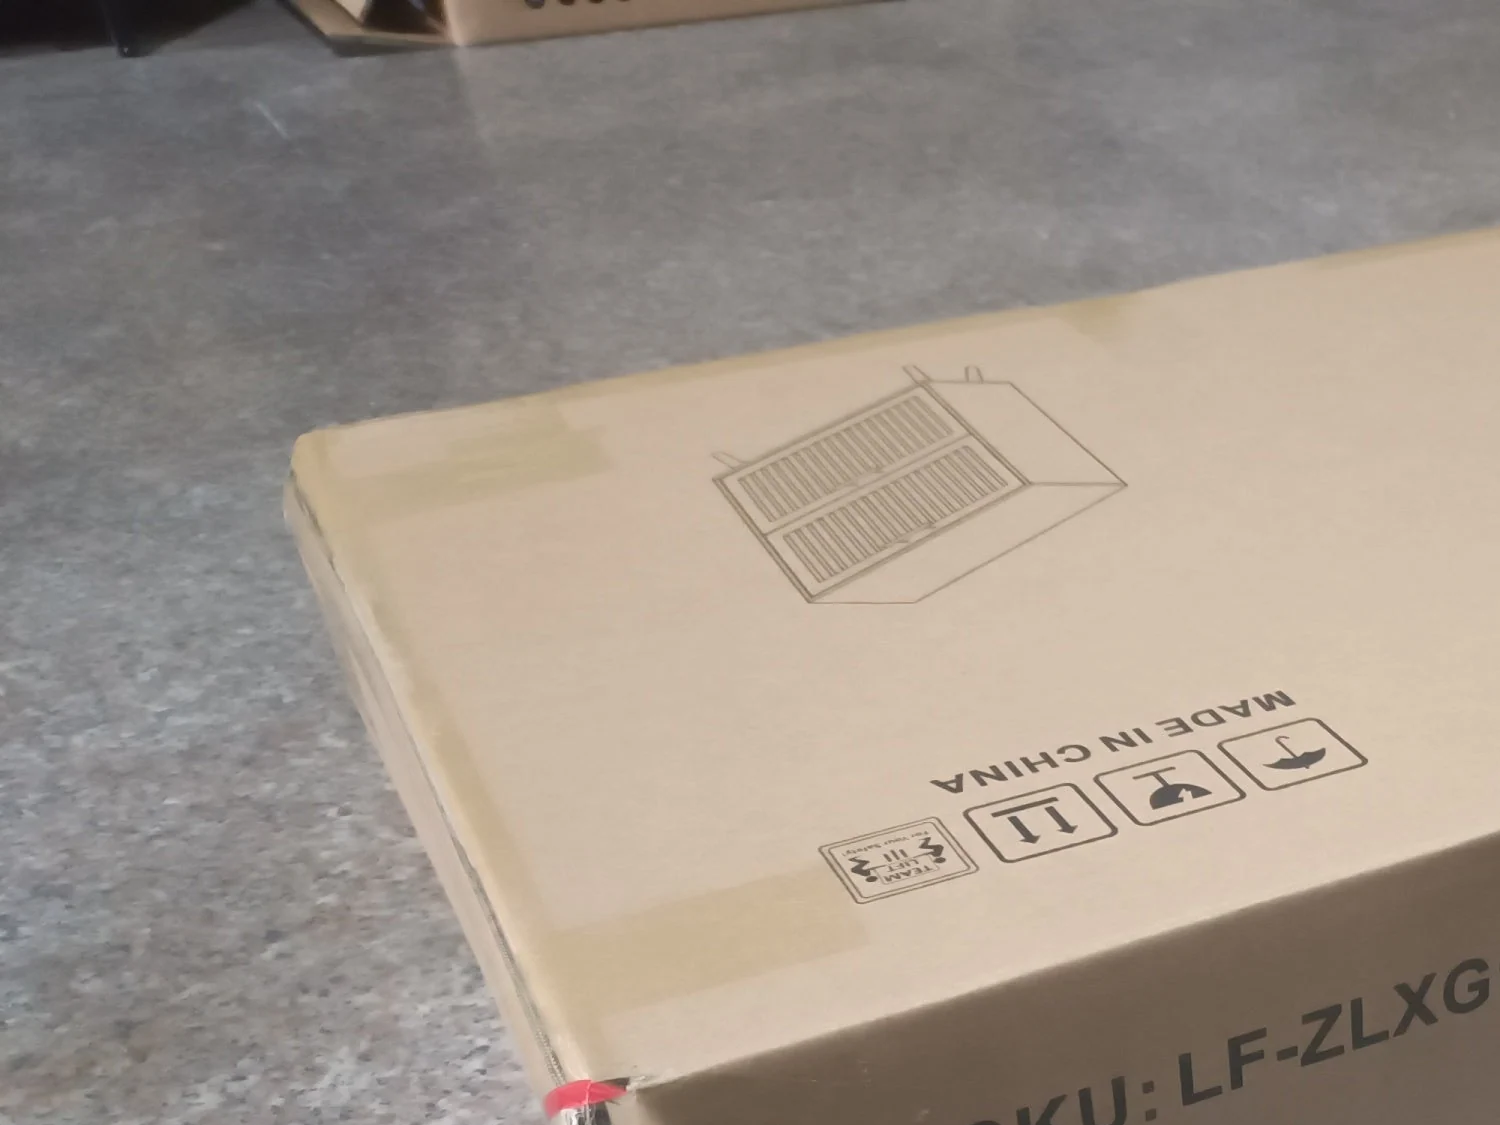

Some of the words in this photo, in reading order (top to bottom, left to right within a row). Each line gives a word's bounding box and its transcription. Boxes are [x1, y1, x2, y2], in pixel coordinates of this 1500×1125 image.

[1155, 691, 1296, 737] MADE
[1099, 728, 1152, 752] IN
[930, 745, 1091, 793] CHINA
[884, 837, 909, 845] Your
[883, 859, 919, 872] LIFT
[884, 866, 932, 882] TEAM
